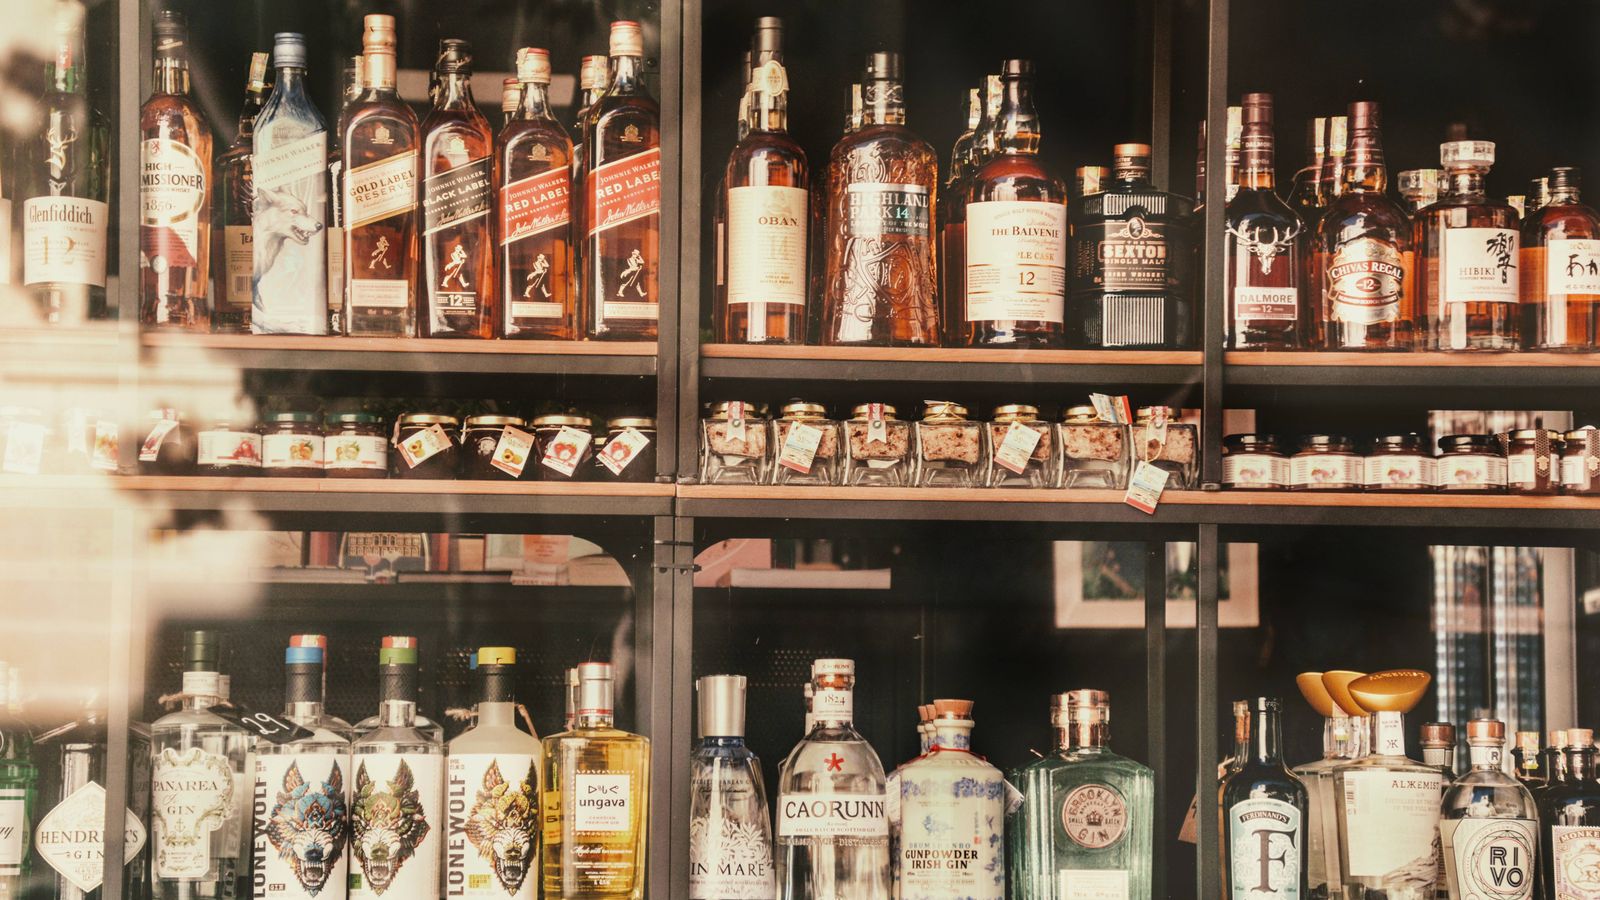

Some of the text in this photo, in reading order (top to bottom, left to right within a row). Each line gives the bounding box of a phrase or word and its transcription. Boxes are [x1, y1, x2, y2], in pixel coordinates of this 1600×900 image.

[141, 173, 203, 190] MISSIONER
[349, 180, 378, 197] GOLD
[379, 168, 415, 187] LABEL
[427, 170, 485, 194] JOHNNIE WALKER
[600, 168, 632, 186] JOHNNIE
[509, 177, 567, 201] JOHNNIE WALKER
[596, 170, 660, 199] RED LABE
[355, 181, 412, 203] RESERVE
[423, 190, 456, 207] BLACK
[457, 179, 491, 195] LABEL
[504, 186, 569, 213] RED LABEL
[850, 192, 929, 208] HIGHLAND
[29, 204, 93, 225] Glenfiddich
[850, 206, 910, 219] PARK 14
[758, 216, 798, 226] OBAN
[991, 226, 1060, 239] THE BALVENIE
[1103, 244, 1166, 258] SEXTON
[1331, 261, 1402, 279] CHIVAS REGAL
[1459, 266, 1496, 276] HIBIKI
[1018, 271, 1035, 286] 12
[1362, 278, 1375, 290] 12
[448, 294, 463, 306] 12
[1240, 294, 1293, 303] DALMORE
[1262, 304, 1272, 313] 12
[824, 693, 846, 706] 1824
[1491, 751, 1499, 760] R
[153, 780, 218, 792] PANAREA
[167, 805, 195, 815] GIN
[579, 798, 626, 810] ungava
[1069, 789, 1122, 817] BROOKLYN
[785, 800, 885, 821] CAORUNN
[1241, 810, 1288, 823] FERDINAND'S
[1104, 817, 1121, 825] BATCH
[40, 828, 139, 844] HENDR'S
[1077, 827, 1110, 844] GIN
[1560, 830, 1600, 843] MONKE
[74, 850, 104, 859] GIN
[905, 849, 978, 860] GUNPOWDER
[1250, 827, 1297, 893] F
[691, 862, 766, 877] IN MARE
[912, 860, 969, 869] IRISH GIN
